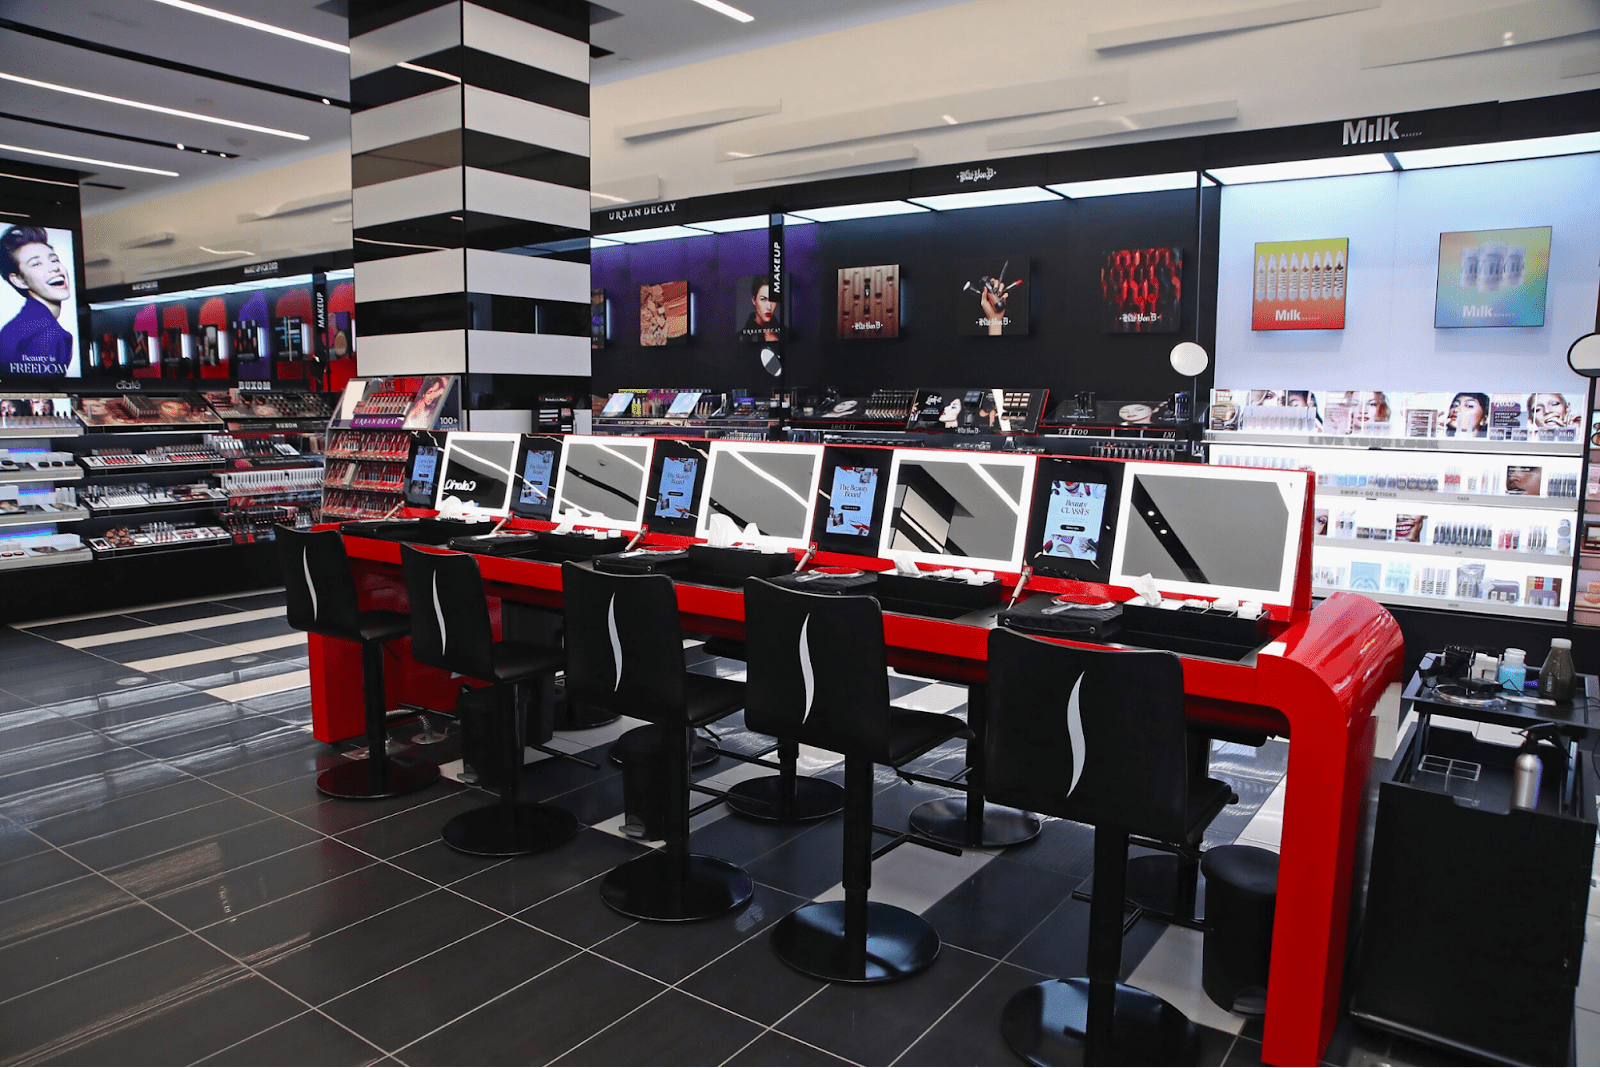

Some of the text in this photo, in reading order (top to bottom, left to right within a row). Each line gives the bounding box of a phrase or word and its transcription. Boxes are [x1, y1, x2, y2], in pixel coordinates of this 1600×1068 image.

[1342, 116, 1399, 145] Milk
[608, 203, 676, 221] URBAN DECAY
[773, 242, 781, 293] MAKEUP
[316, 292, 325, 328] MAKEUP
[1275, 309, 1301, 321] Milk
[1463, 305, 1493, 317] Milk
[22, 355, 48, 363] Beauty
[238, 381, 271, 390] BUXOM
[1308, 436, 1439, 449] LIVE YOUR LOOK
[850, 485, 868, 493] Beauty
[1066, 499, 1088, 507] Beauty
[1061, 507, 1090, 515] CLASSES
